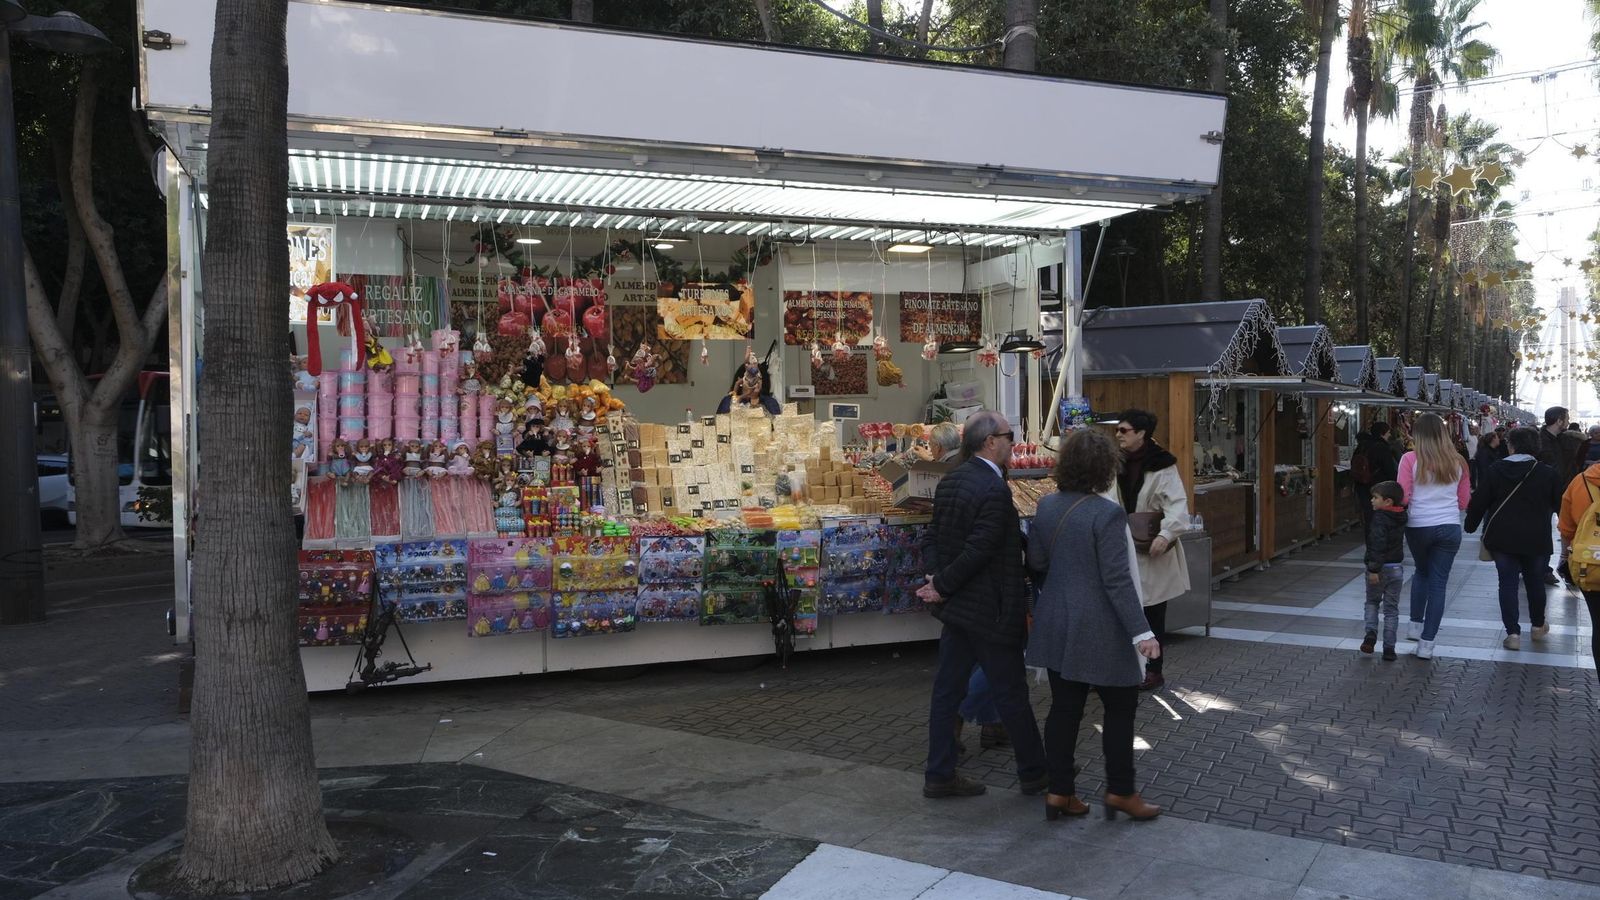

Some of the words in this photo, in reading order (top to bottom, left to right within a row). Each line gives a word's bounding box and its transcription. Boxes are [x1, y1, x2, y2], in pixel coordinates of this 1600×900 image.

[364, 285, 423, 302] REGALIZ
[558, 287, 599, 297] CARAMELO
[680, 288, 729, 300] TURRONES
[904, 298, 941, 310] PIÑONATE
[941, 300, 979, 311] ARTESANO
[680, 305, 732, 317] ARTESANOS
[912, 322, 924, 333] DE
[925, 323, 970, 336] ALMENDRA
